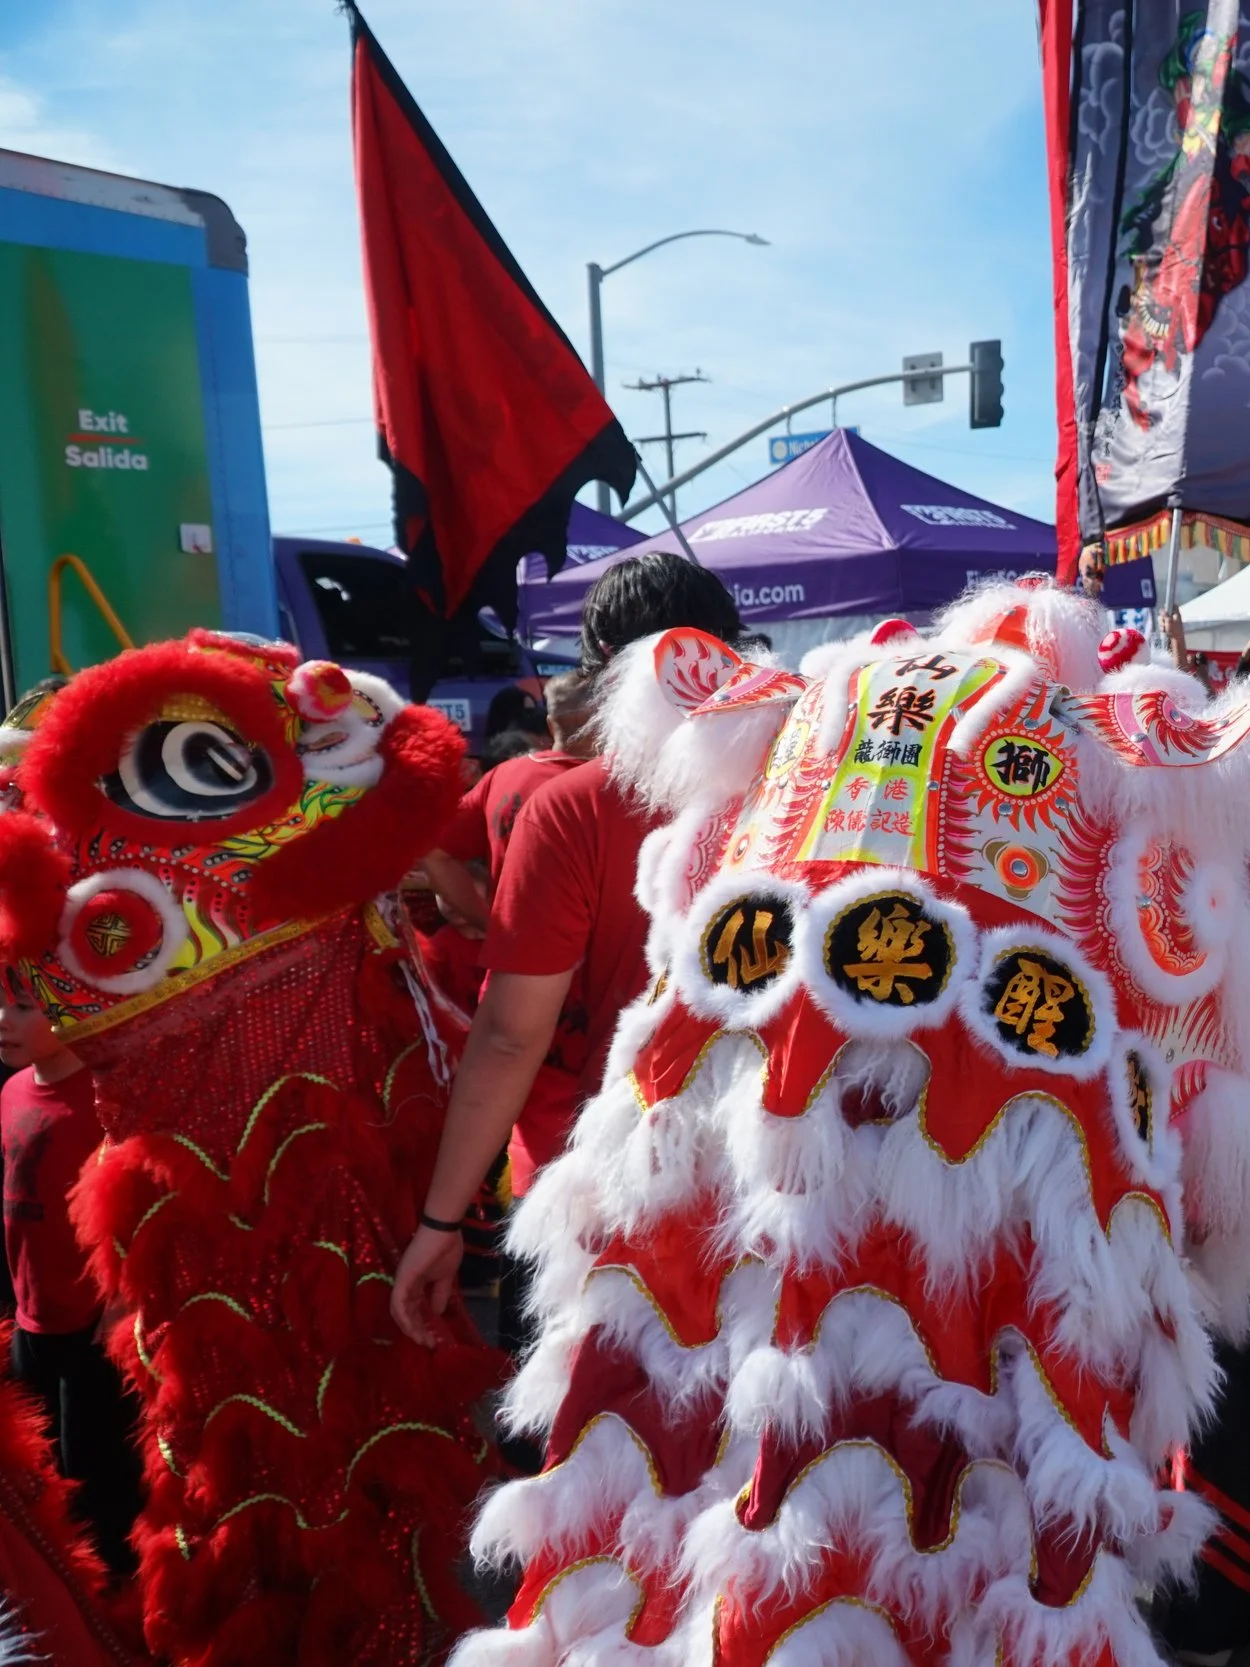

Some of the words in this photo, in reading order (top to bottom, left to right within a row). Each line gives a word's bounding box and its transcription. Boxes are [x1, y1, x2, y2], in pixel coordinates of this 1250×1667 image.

[78, 409, 128, 433] Exit
[65, 445, 149, 470] Salida
[732, 583, 805, 606] ia.com
[989, 739, 1050, 794] 獅
[845, 776, 909, 801] 香港
[713, 908, 790, 988] 仙
[843, 903, 932, 1004] 樂
[995, 958, 1075, 1058] 醒
